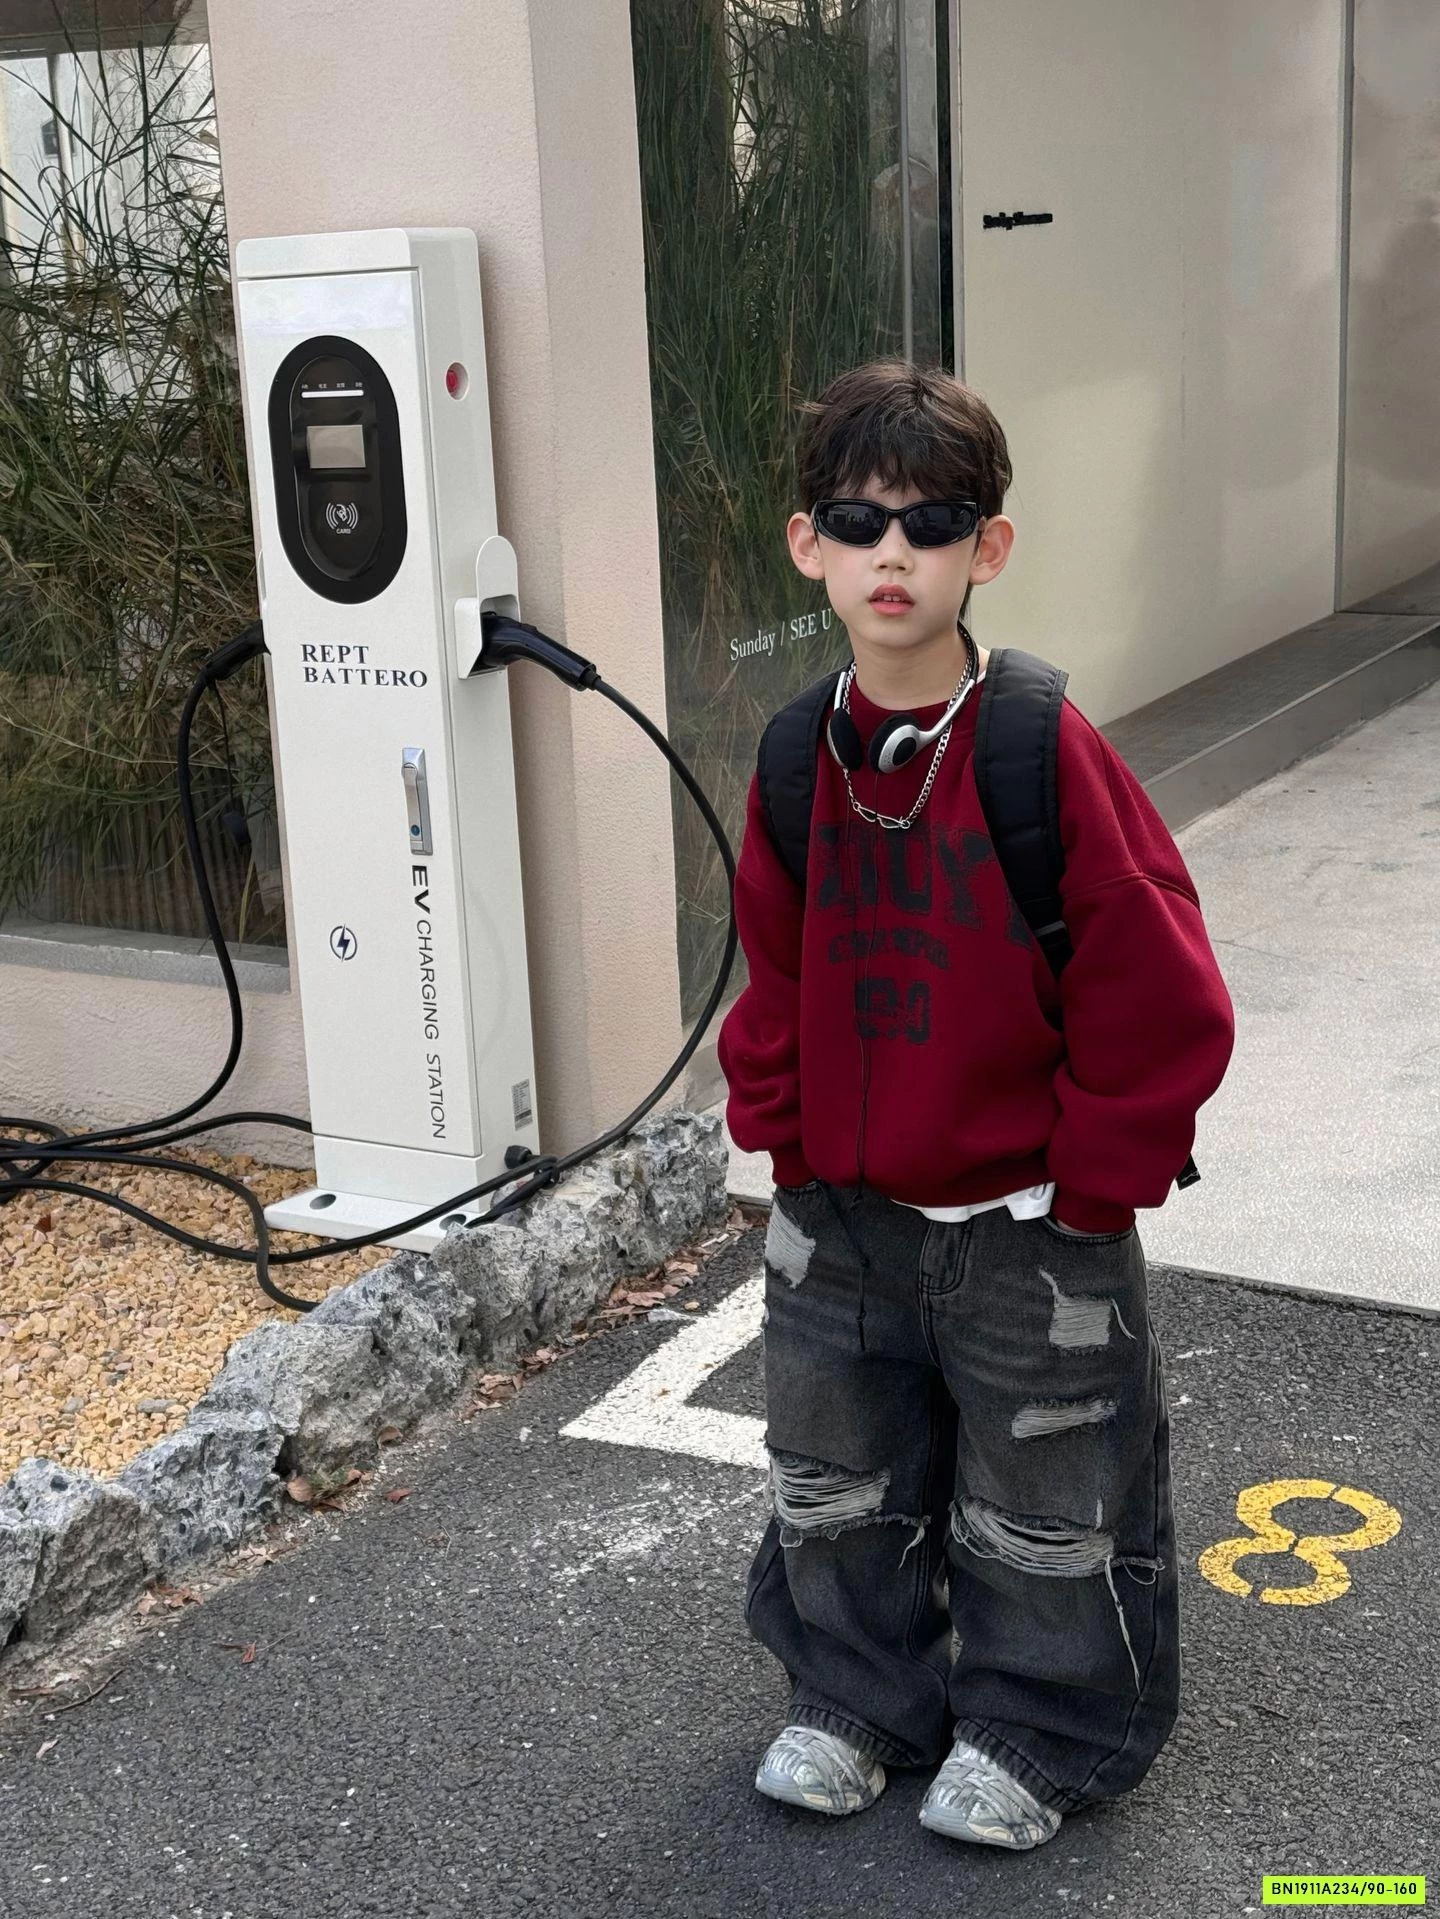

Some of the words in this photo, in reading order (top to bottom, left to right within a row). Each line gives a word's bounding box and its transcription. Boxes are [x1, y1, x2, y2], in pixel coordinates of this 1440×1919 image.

[301, 644, 369, 664] REPT
[730, 630, 776, 661] Sunday
[790, 613, 817, 641] SEE
[304, 666, 428, 688] BATTERO
[412, 865, 430, 914] EV
[416, 919, 439, 1040] CHARGING
[426, 1053, 446, 1139] STATION
